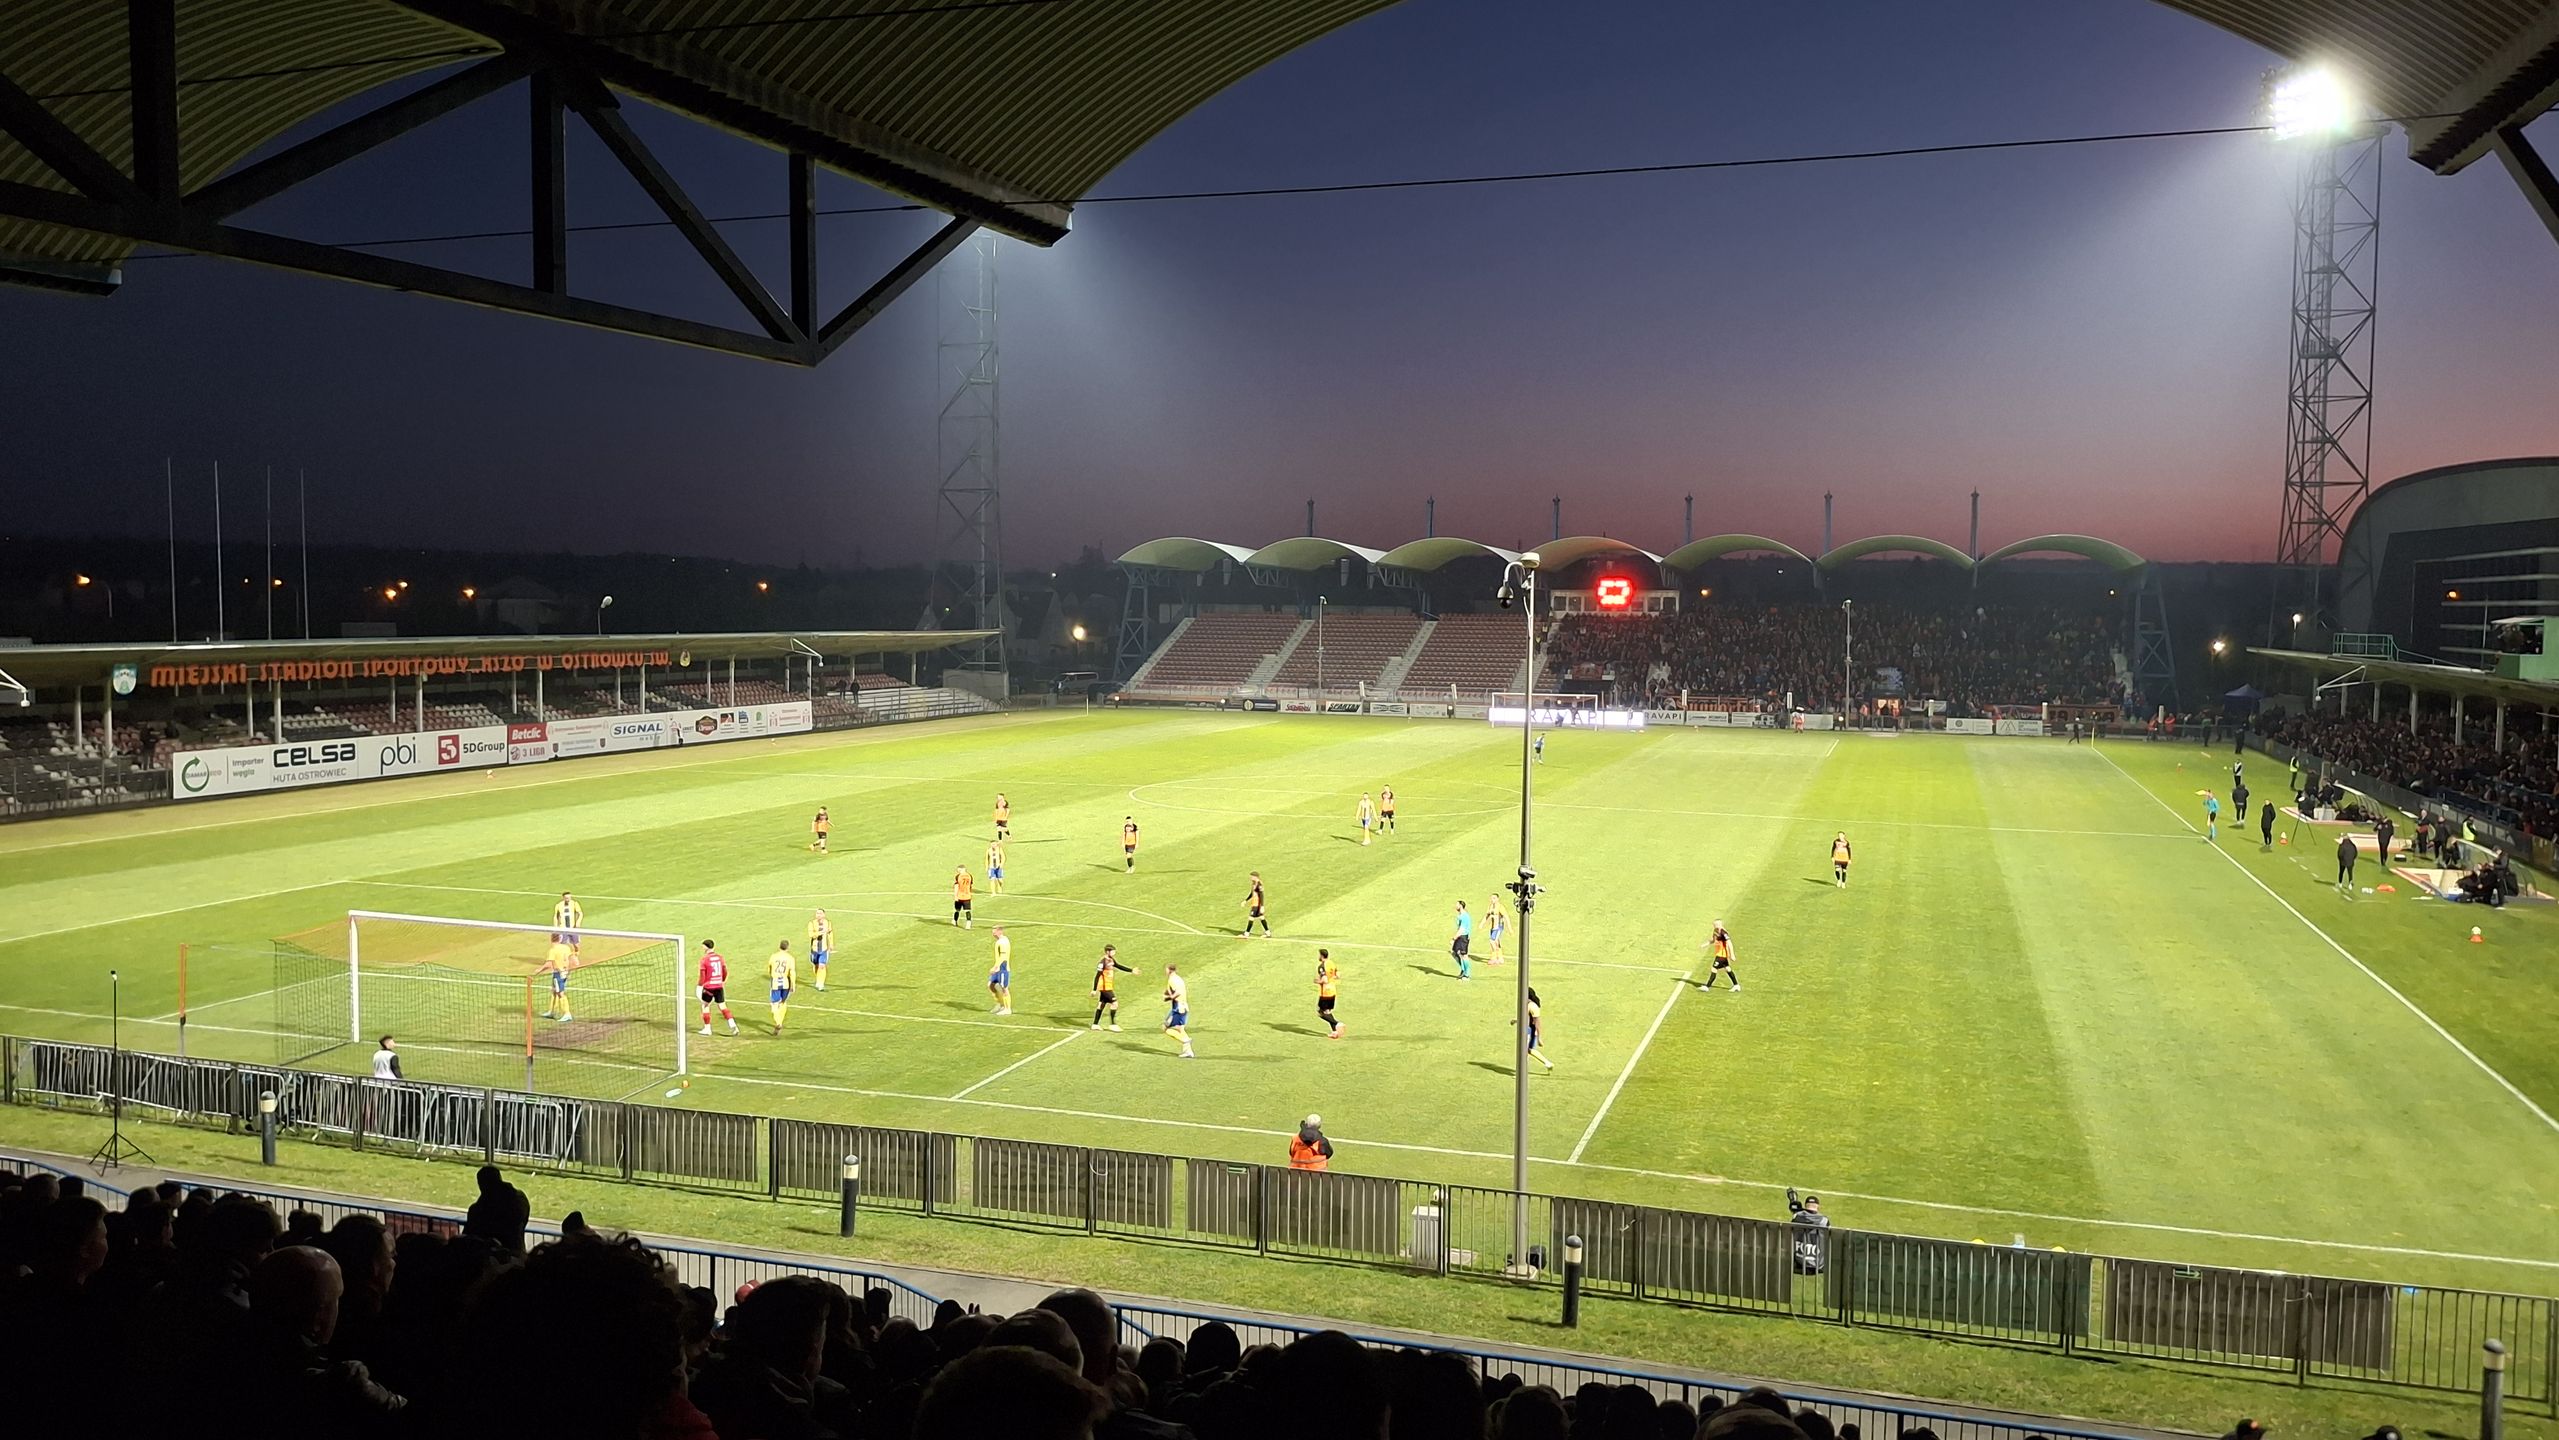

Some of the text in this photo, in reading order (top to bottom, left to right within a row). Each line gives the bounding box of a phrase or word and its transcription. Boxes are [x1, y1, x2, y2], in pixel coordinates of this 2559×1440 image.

[150, 663, 247, 687] MIEJSKI
[260, 660, 353, 681] STADION
[362, 656, 469, 678] SPORTOWY
[562, 651, 644, 670] OSTROWCU
[512, 727, 541, 740] Betclic
[613, 722, 663, 736] SIGNAL
[463, 742, 506, 754] 5DGroup
[380, 736, 416, 775] pbi
[273, 768, 348, 783] HUTA OSTROWIEC
